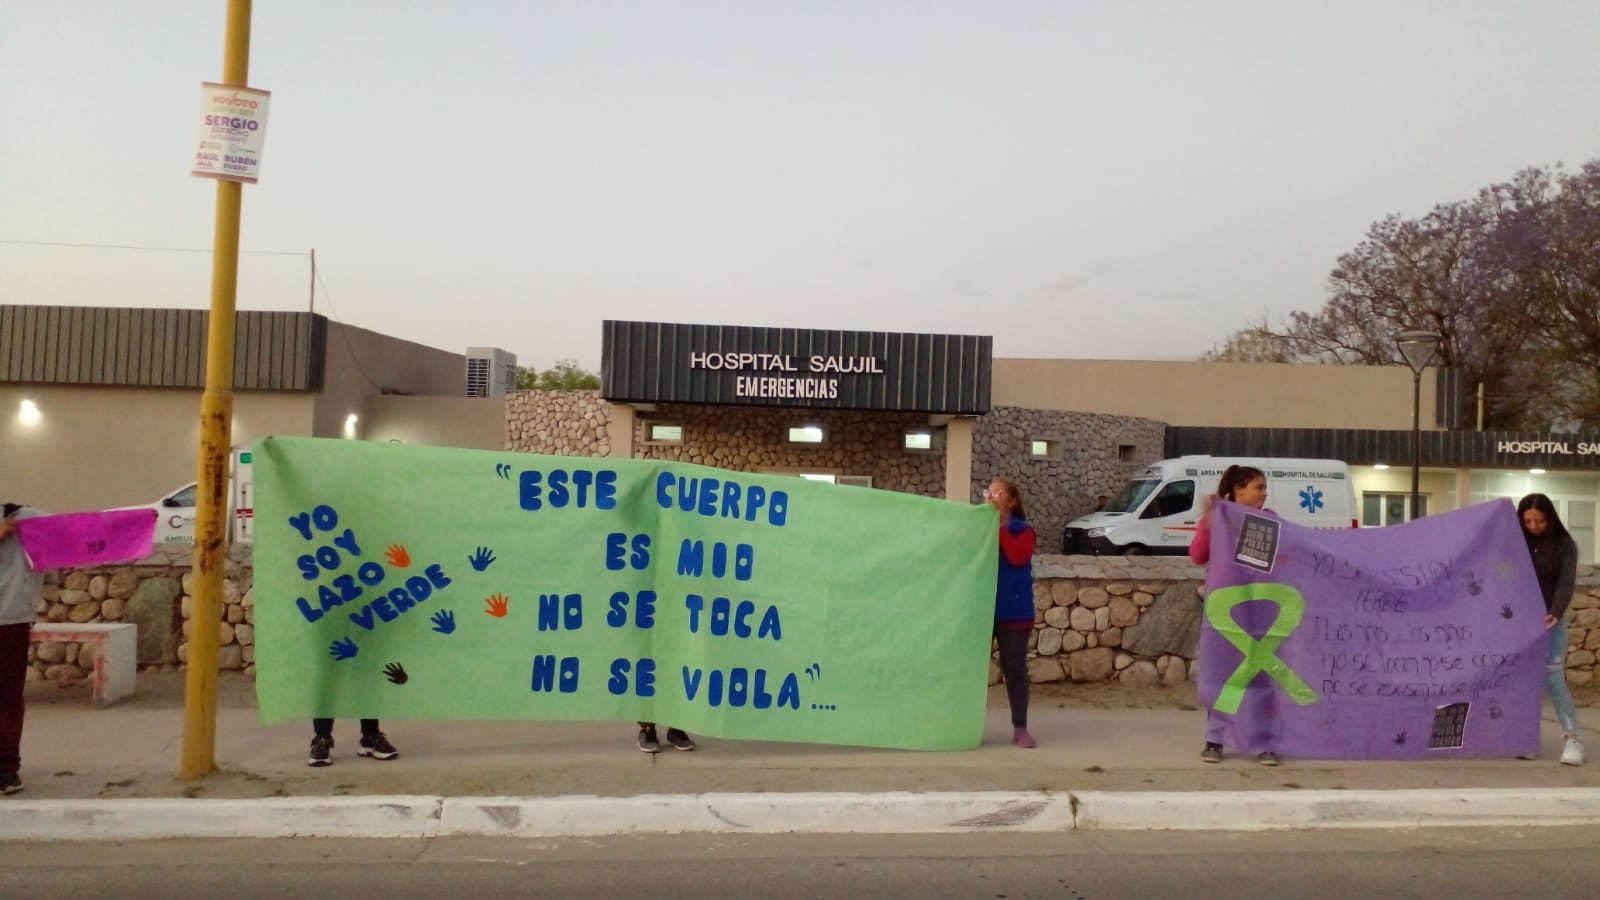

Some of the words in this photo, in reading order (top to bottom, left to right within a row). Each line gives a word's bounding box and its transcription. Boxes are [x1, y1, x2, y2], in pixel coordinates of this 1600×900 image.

[205, 114, 259, 131] SERGIO
[690, 352, 798, 372] HOSPITAL
[809, 355, 884, 374] SAUJIL
[736, 376, 839, 399] EMERGENCIAS
[1498, 441, 1574, 455] HOSPITAL
[656, 472, 788, 526] CUERPO
[288, 504, 338, 541] YO
[297, 528, 361, 581] SOY
[607, 534, 649, 570] ES
[678, 540, 752, 580] MIO
[295, 561, 385, 623] LAZO
[349, 563, 452, 630] VERDE
[539, 595, 581, 630] NO
[608, 592, 656, 628] SE
[686, 596, 780, 640] TOCA
[533, 656, 578, 692] NO
[608, 659, 654, 696] SE
